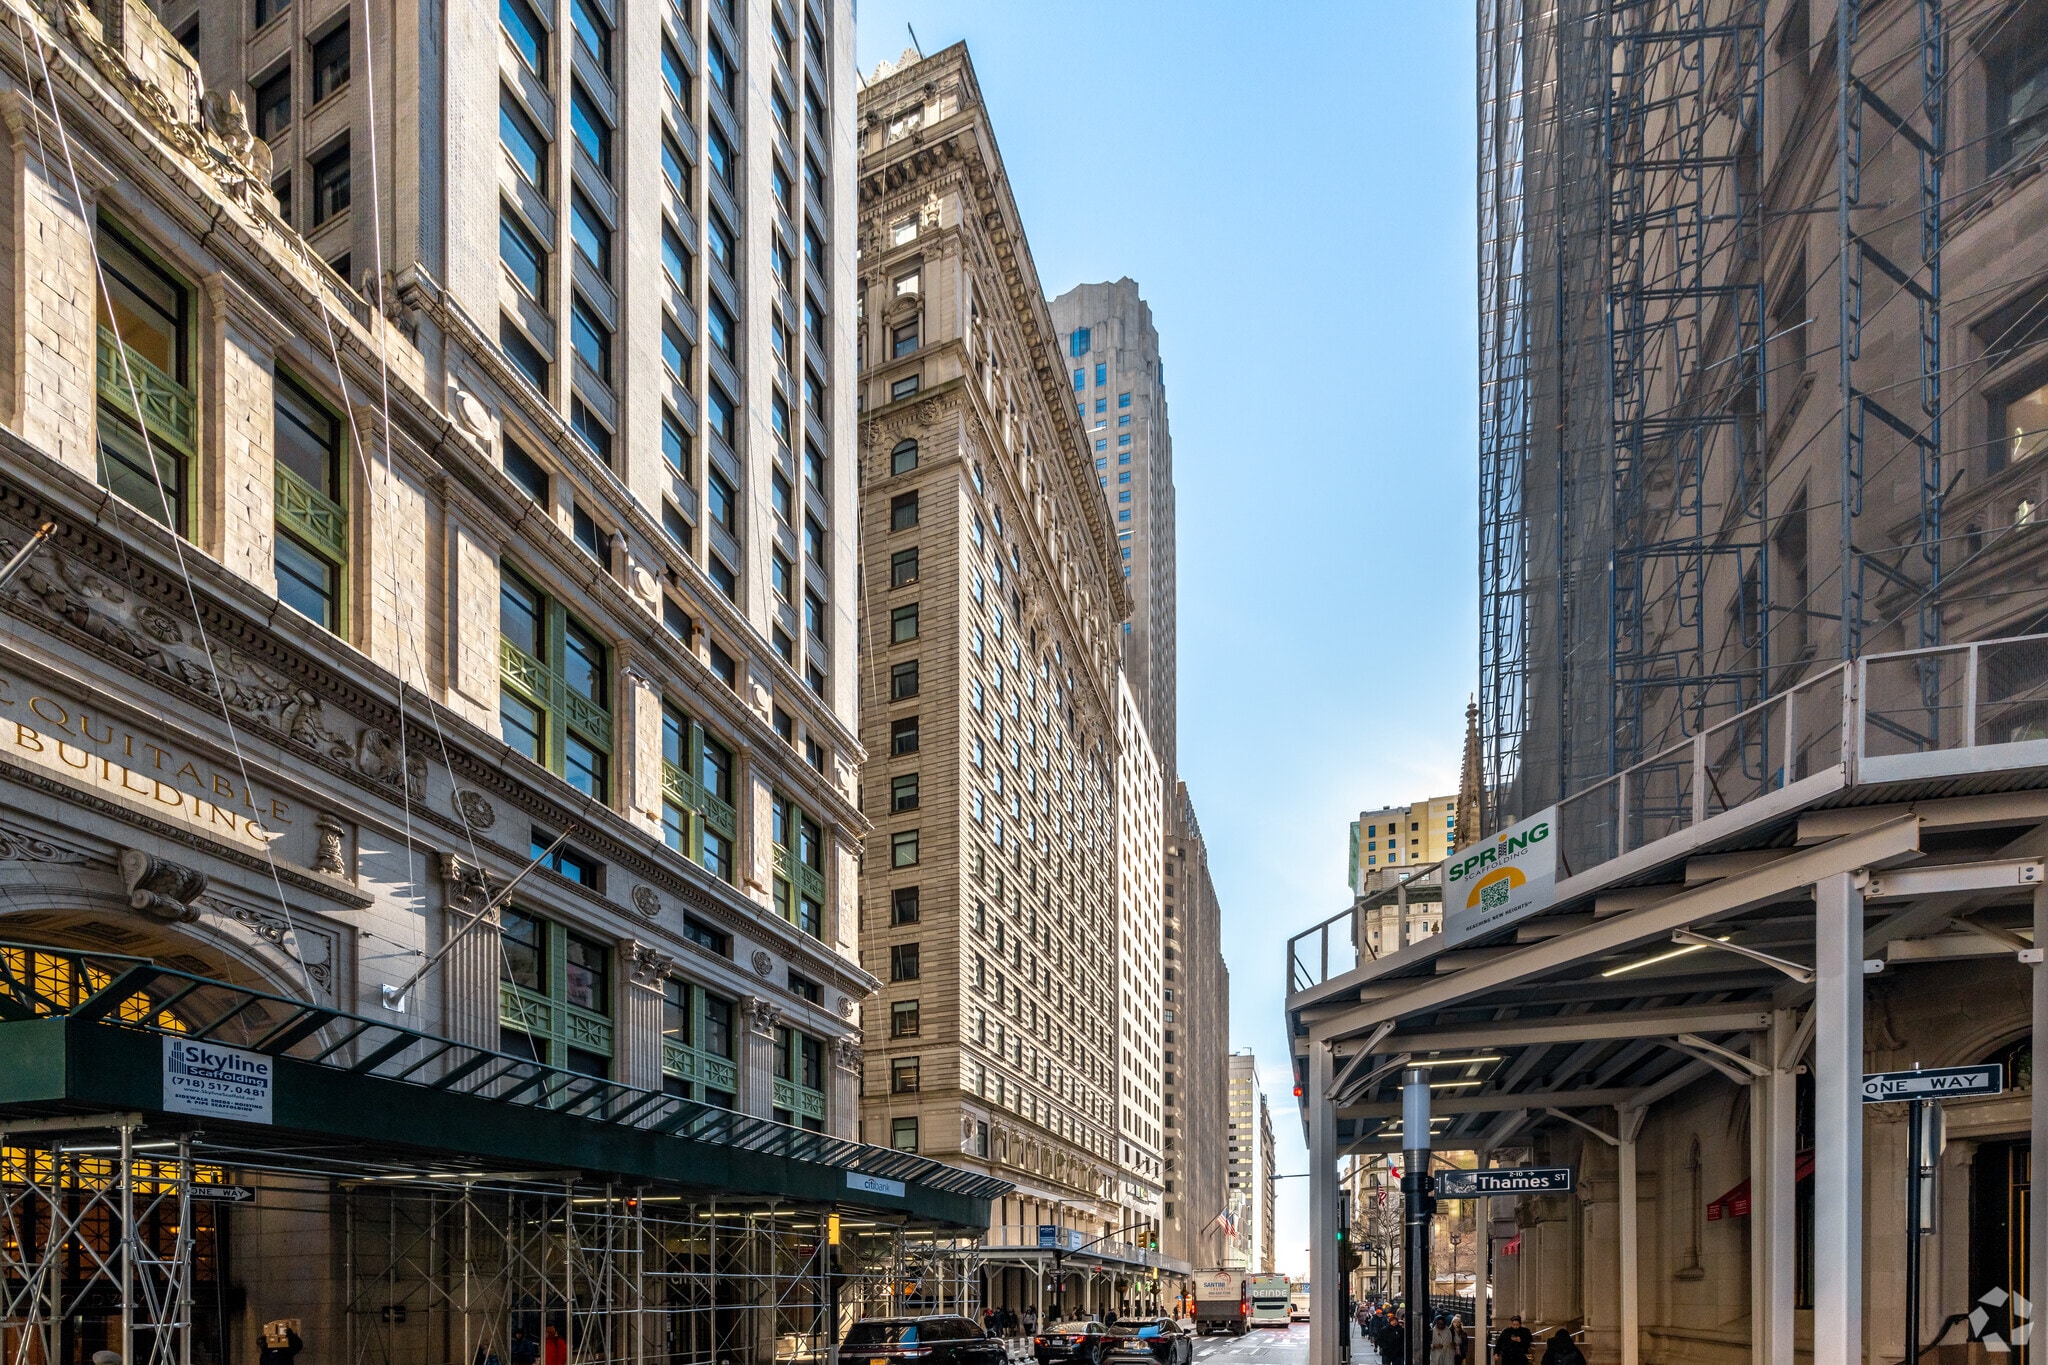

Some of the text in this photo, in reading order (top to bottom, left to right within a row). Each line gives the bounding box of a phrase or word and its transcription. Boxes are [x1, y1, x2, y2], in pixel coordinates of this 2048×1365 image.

[14, 720, 271, 843] BUILDING
[1464, 848, 1529, 882] SCAFFOLDING
[1465, 917, 1491, 932] REACHING
[1492, 911, 1504, 921] NEW
[185, 1046, 268, 1075] Skyline
[190, 1066, 264, 1087] Scaffolding
[1865, 1075, 1978, 1094] ONE WAY
[171, 1076, 265, 1098] (718) 517.0481
[174, 1093, 208, 1102] SIDEWALK
[211, 1102, 253, 1112] SCAFFOLDING
[864, 1180, 890, 1192] citibank
[1479, 1173, 1566, 1190] Thames ST
[191, 1187, 245, 1197] ONE WAY
